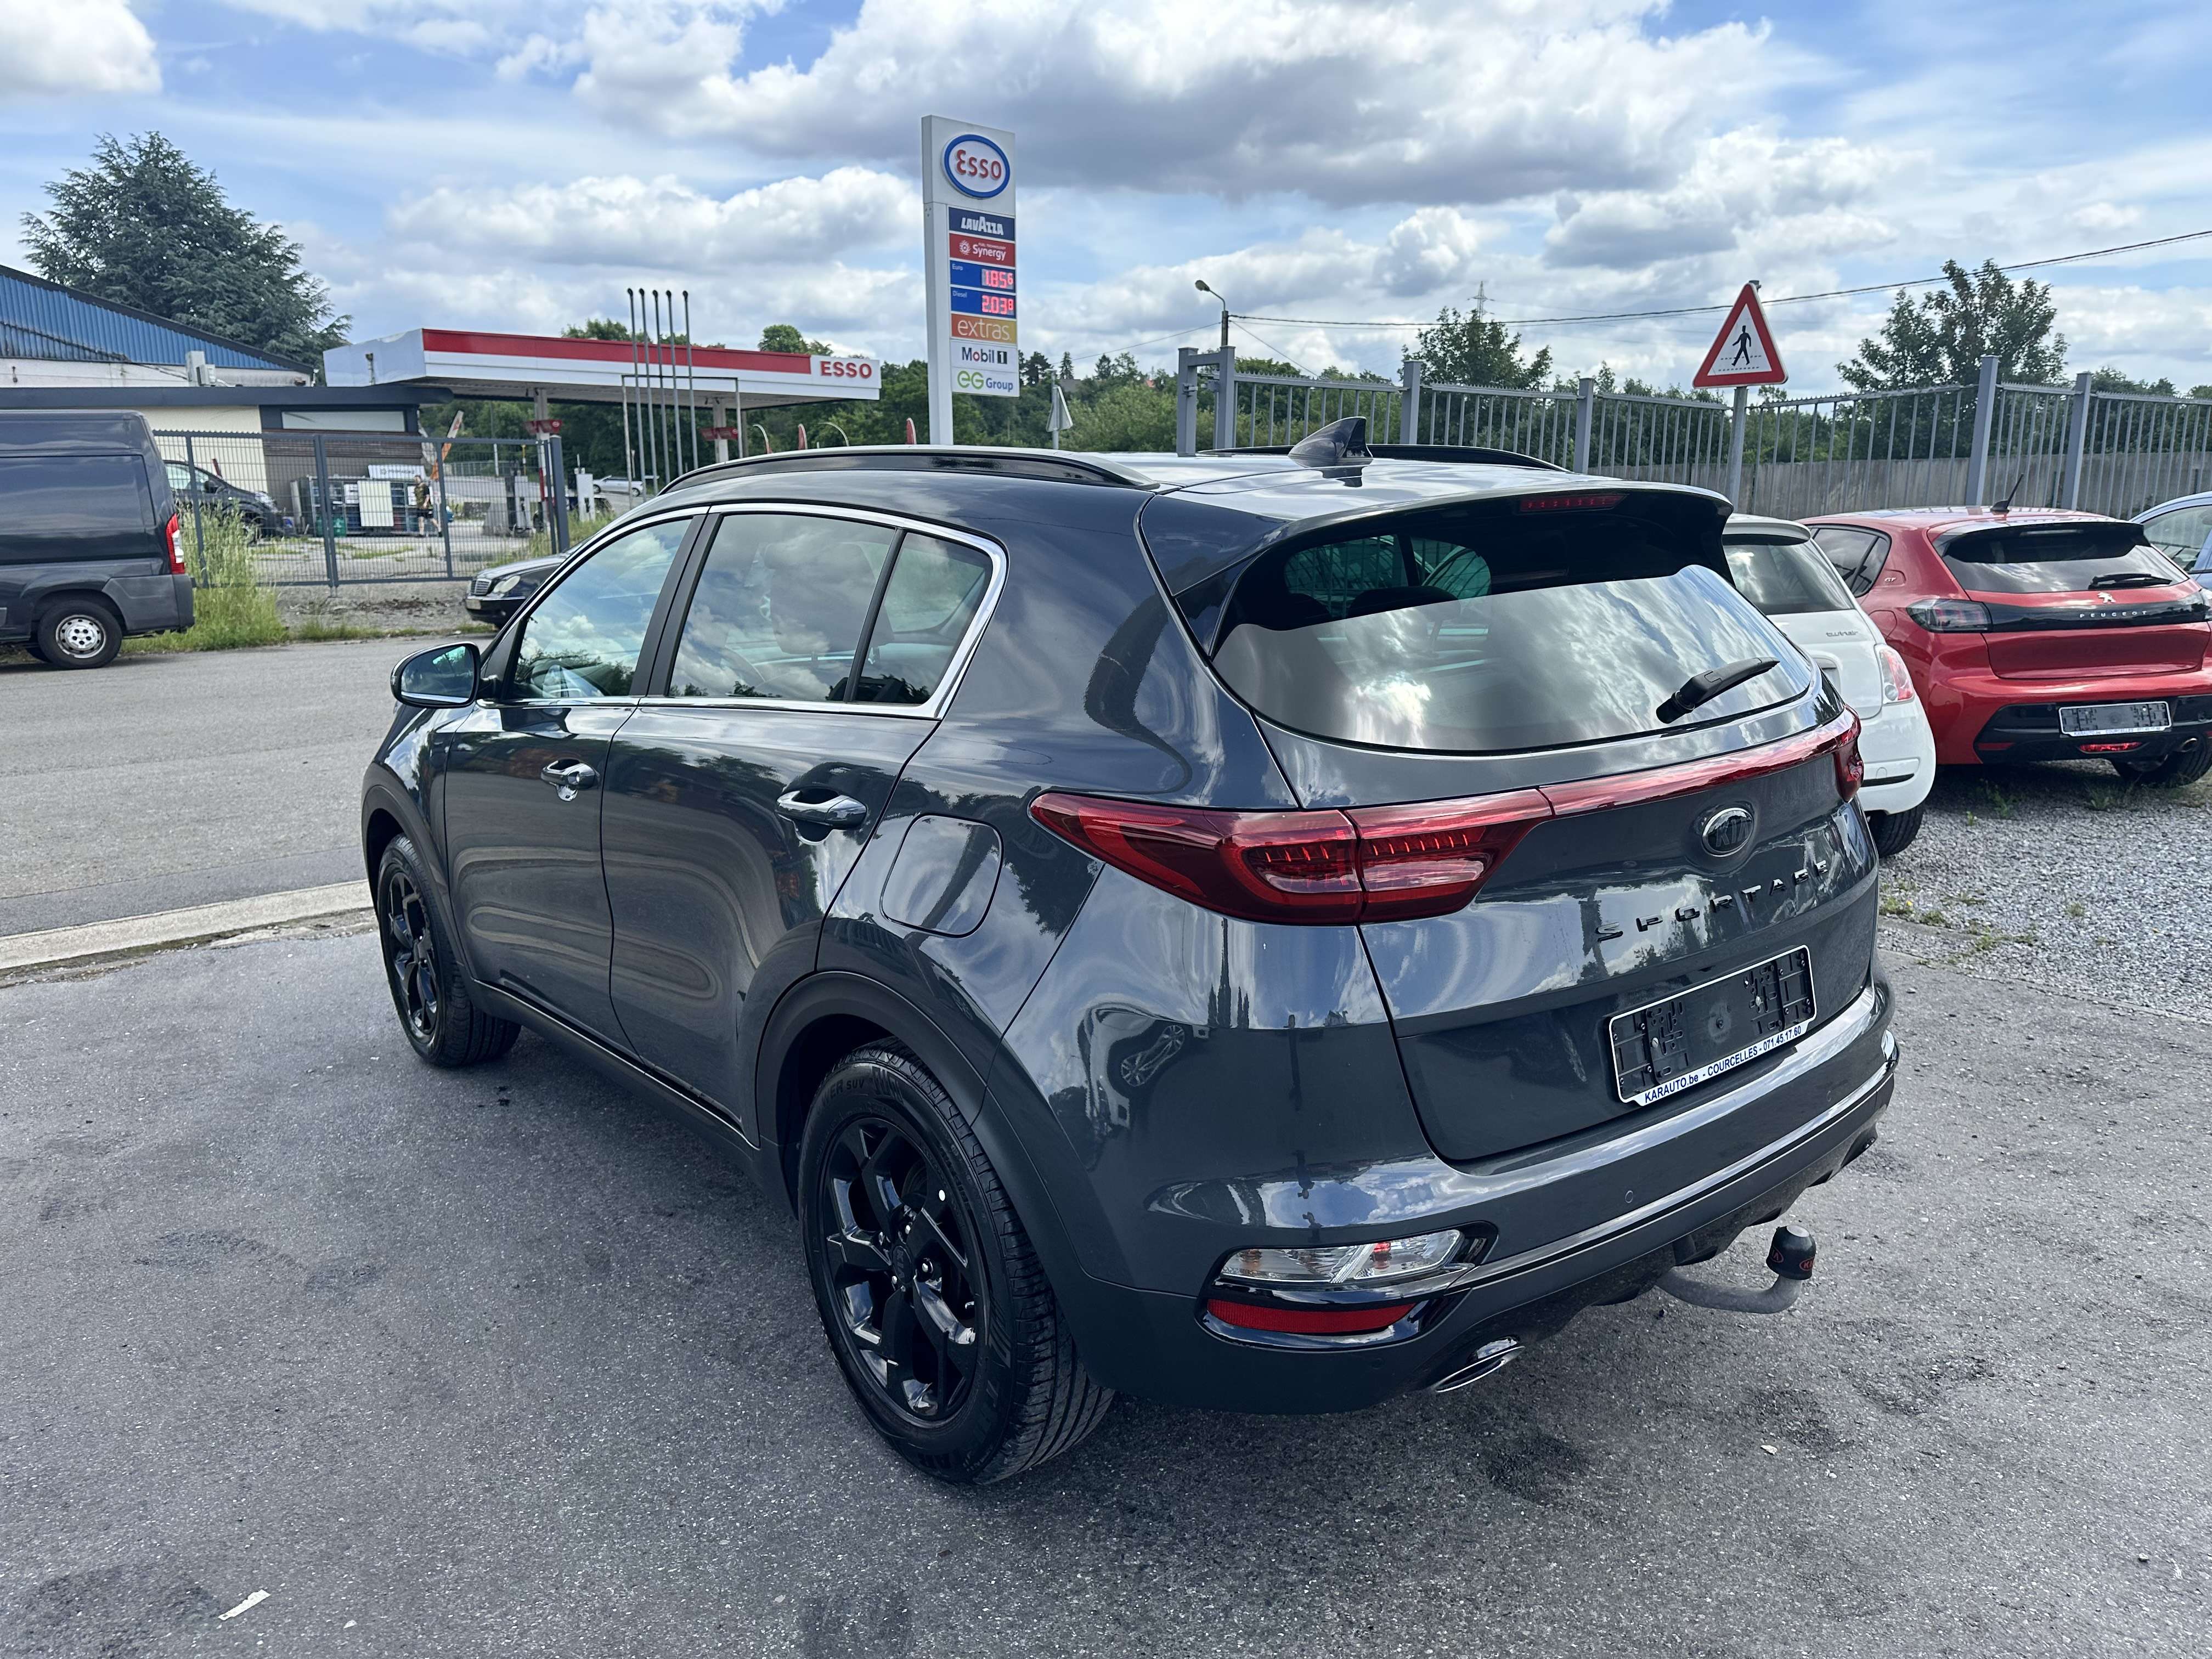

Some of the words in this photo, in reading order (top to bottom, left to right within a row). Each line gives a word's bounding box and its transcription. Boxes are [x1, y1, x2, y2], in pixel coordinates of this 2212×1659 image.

[961, 216, 1004, 235] LAVAZZA
[972, 244, 1006, 261] Synergy
[962, 347, 995, 364] Mobil
[998, 351, 1007, 364] 1
[820, 361, 872, 379] ESSO
[986, 377, 1013, 392] Group
[1716, 818, 1752, 848] KIA
[1596, 860, 1828, 943] SPORTAGE
[1645, 1074, 1699, 1103] KARAUTO.be
[1708, 1046, 1758, 1076] COURCELLES
[1763, 1025, 1801, 1051] 071.45.17.60
[846, 1079, 865, 1090] SUV
